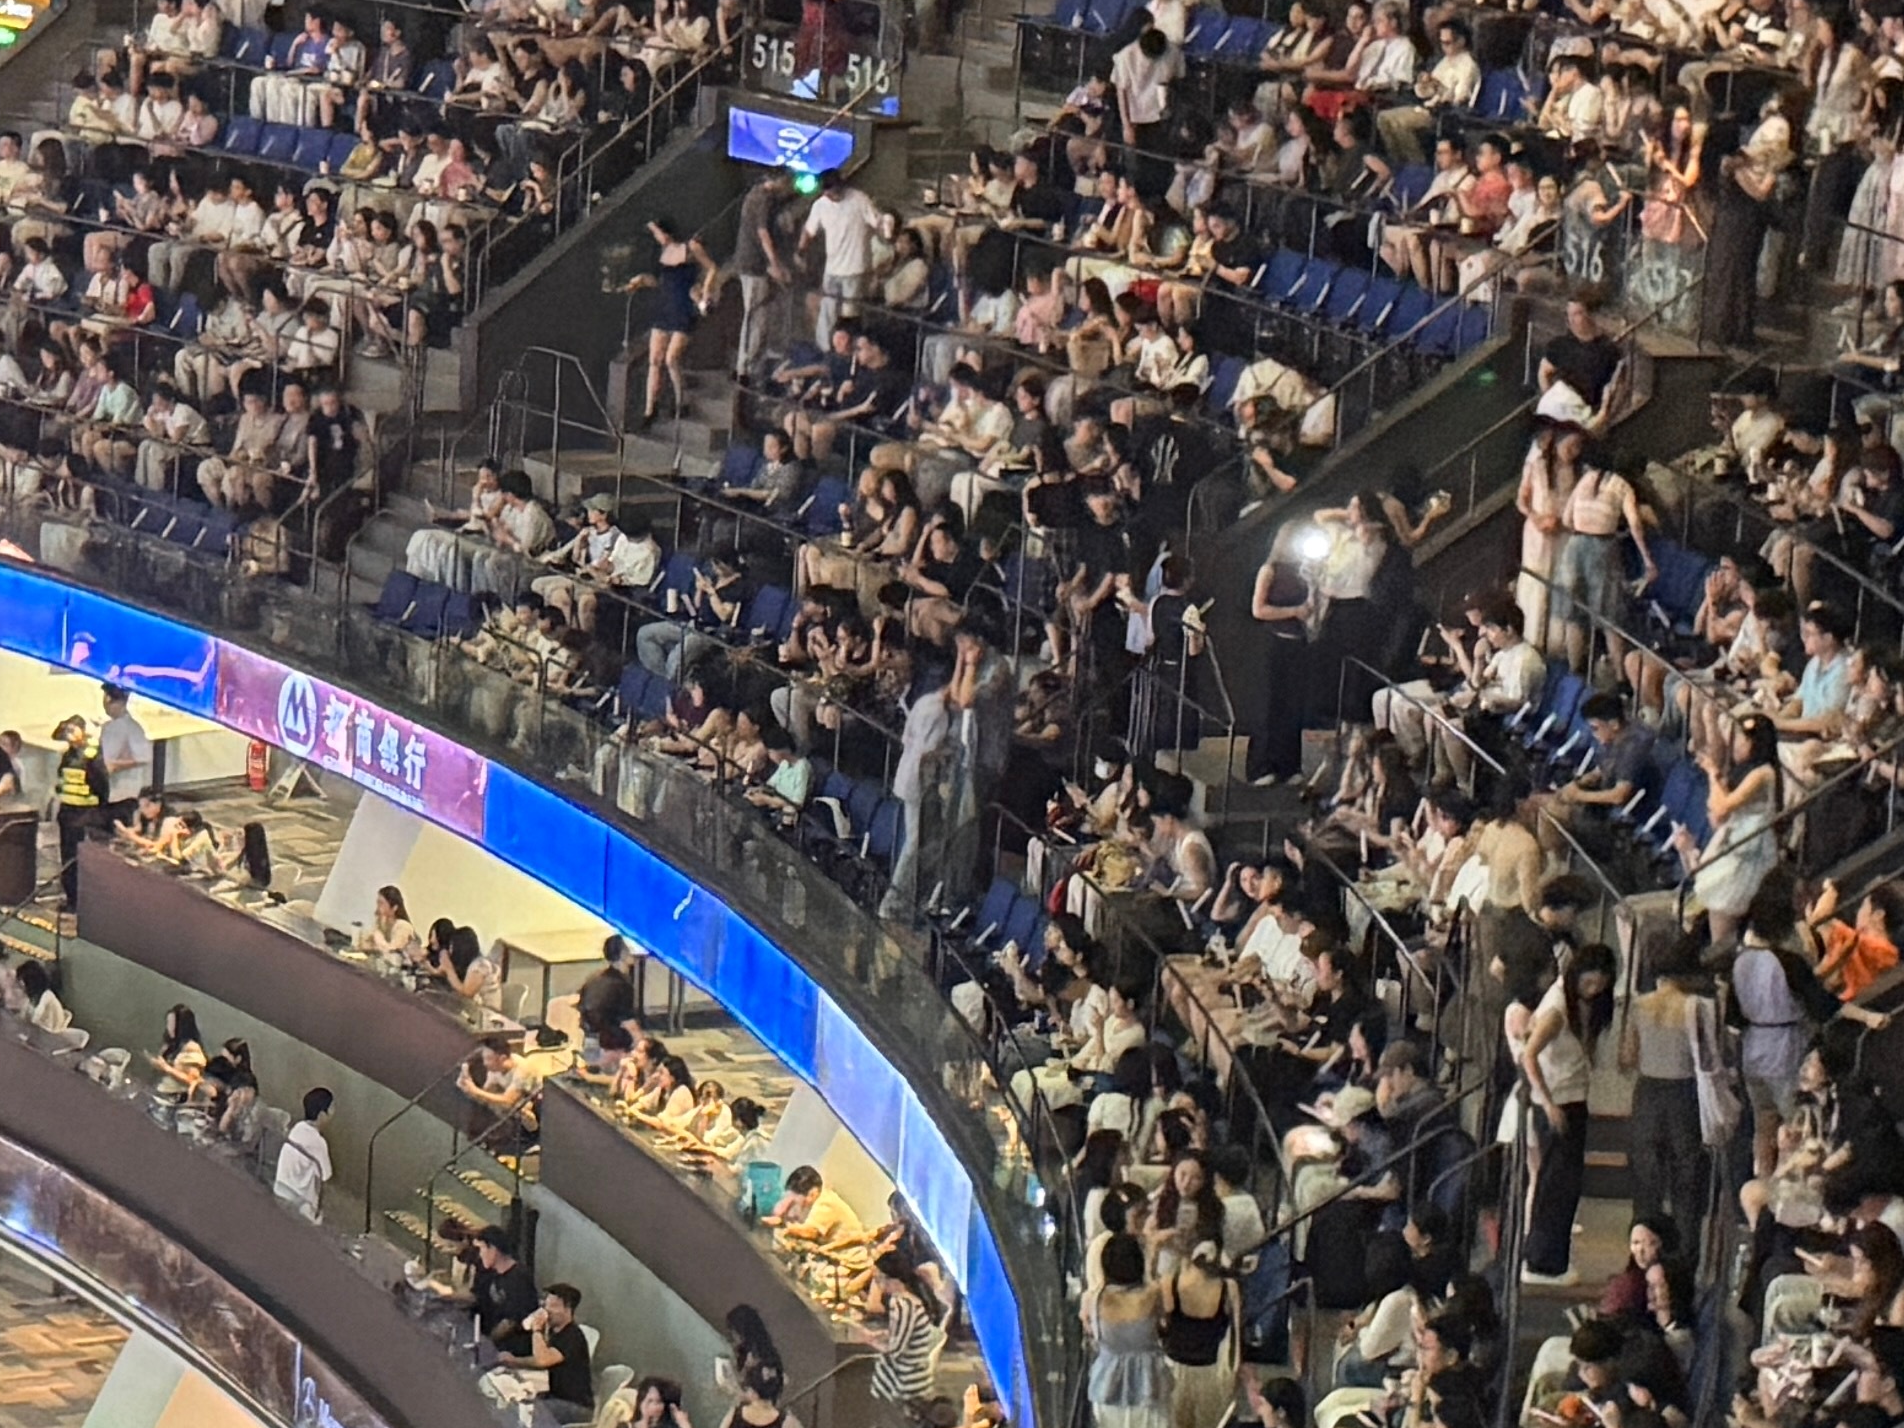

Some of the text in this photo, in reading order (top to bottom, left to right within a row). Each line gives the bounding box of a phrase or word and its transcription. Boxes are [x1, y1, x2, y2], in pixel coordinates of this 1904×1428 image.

[752, 33, 796, 77] 515
[846, 52, 890, 94] 516
[1564, 233, 1603, 283] 516
